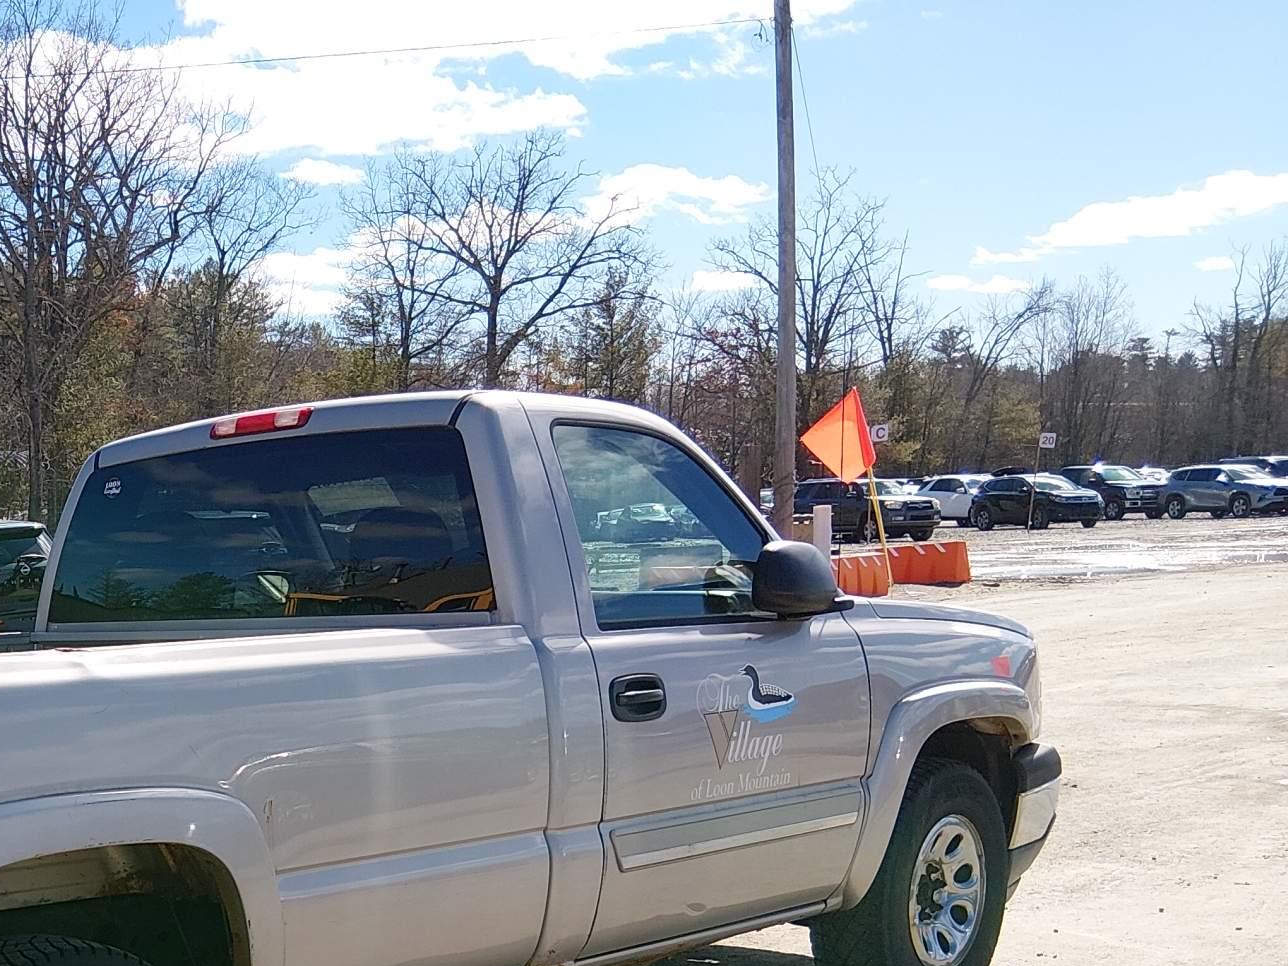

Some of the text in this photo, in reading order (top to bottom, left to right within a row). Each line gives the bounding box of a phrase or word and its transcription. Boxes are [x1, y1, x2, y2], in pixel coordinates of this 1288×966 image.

[875, 427, 886, 439] C
[1042, 436, 1055, 445] 20
[691, 767, 791, 800] of Loon Mountain
